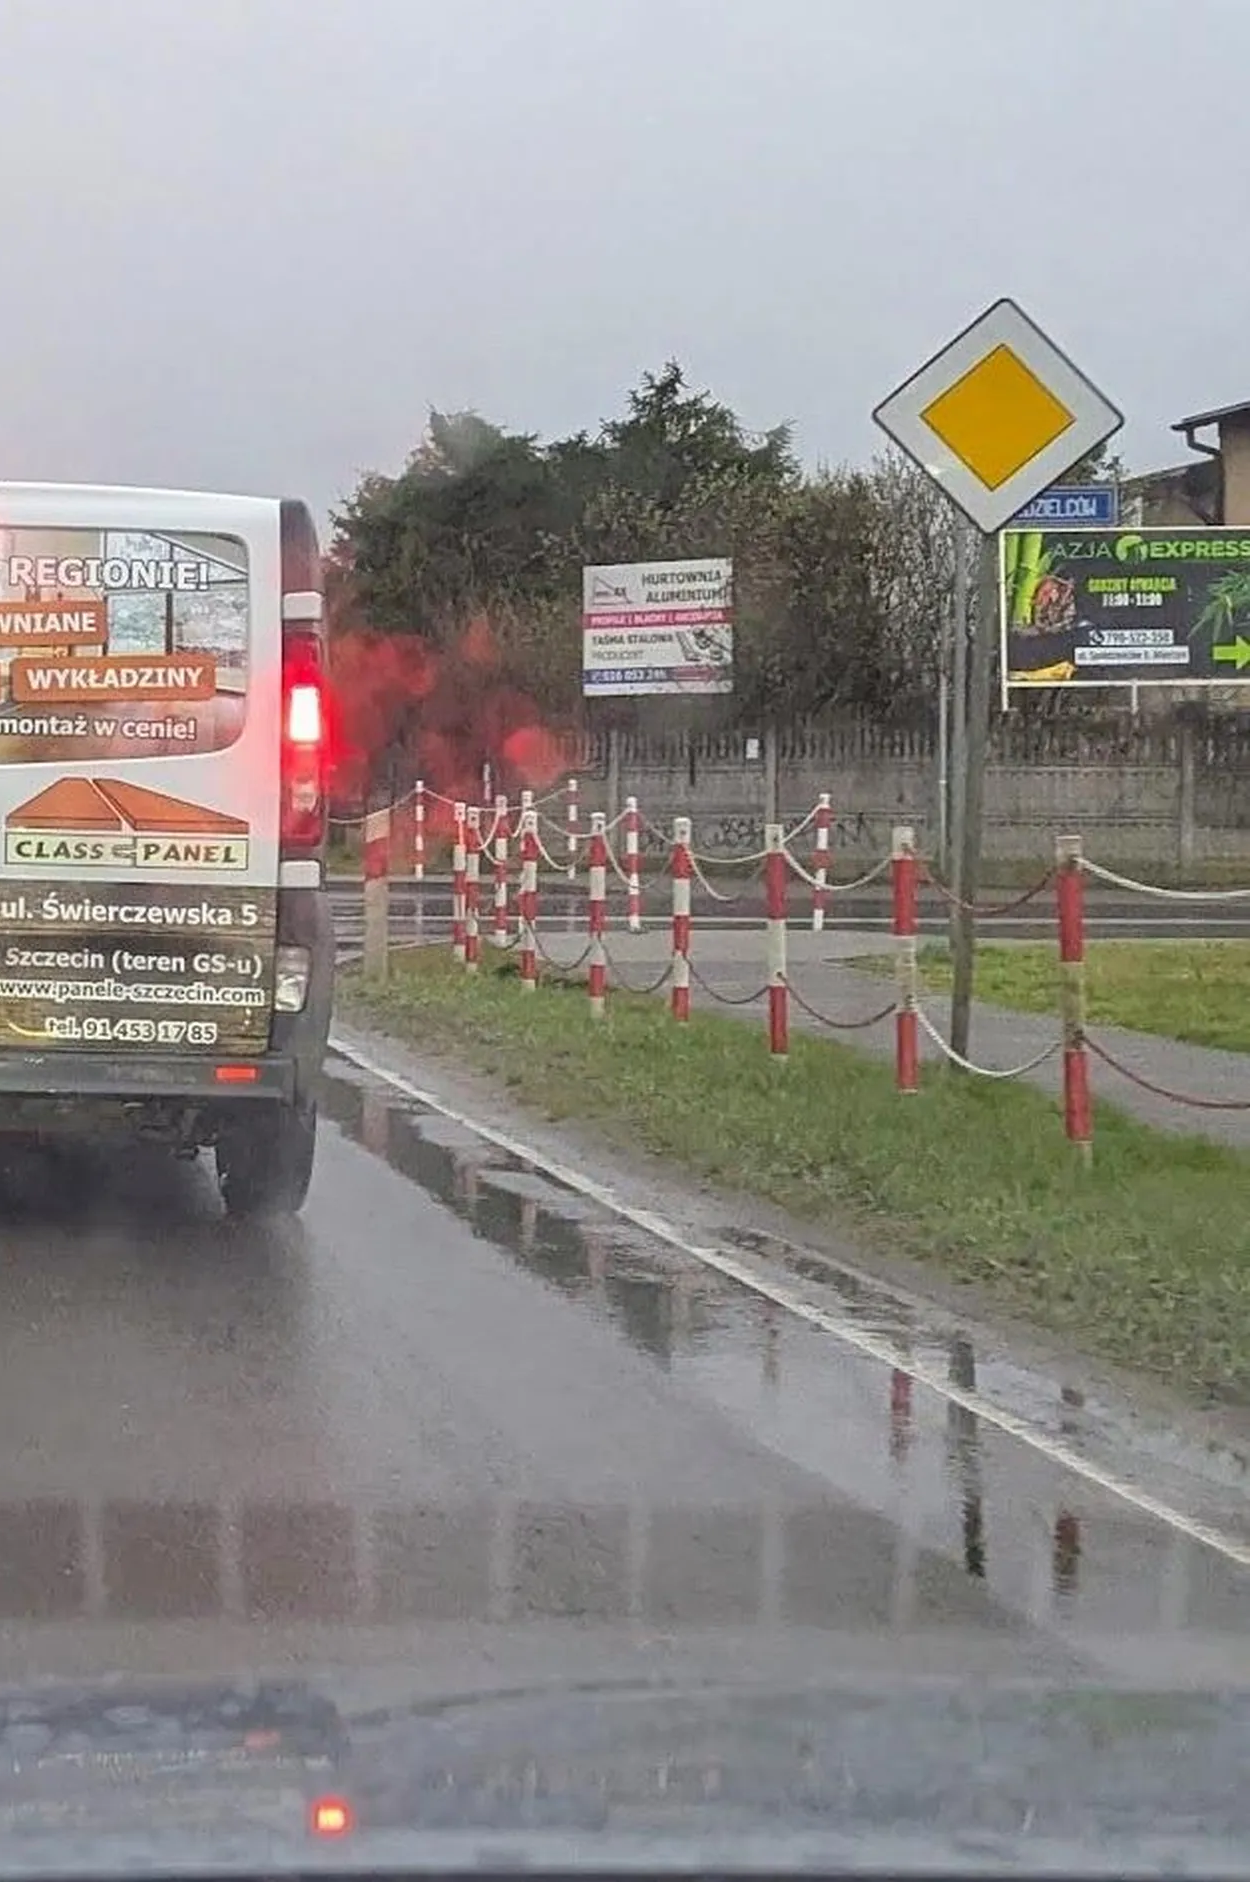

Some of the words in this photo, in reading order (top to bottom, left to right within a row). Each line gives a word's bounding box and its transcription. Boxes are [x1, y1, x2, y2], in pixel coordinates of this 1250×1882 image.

[1053, 542, 1112, 559] AZJA
[1150, 541, 1250, 558] EXPRESS
[8, 556, 211, 592] REGIONIE!
[642, 569, 722, 586] HURTOWNIA
[646, 587, 727, 603] ALUMINIUM
[26, 666, 203, 690] WYKŁADZINY
[94, 721, 116, 737] w
[122, 718, 198, 740] cenie!
[14, 840, 104, 860] CLASS
[142, 843, 238, 863] PANEL
[0, 898, 34, 920] ul.
[41, 892, 232, 926] Świerczewska
[241, 904, 258, 926] 5
[5, 948, 104, 970] Szczecin
[111, 949, 186, 974] (teren
[192, 953, 263, 978] GS-u)
[47, 1018, 81, 1038] tel.
[115, 1020, 155, 1041] 453
[159, 1022, 186, 1041] 17
[189, 1023, 218, 1043] 85
